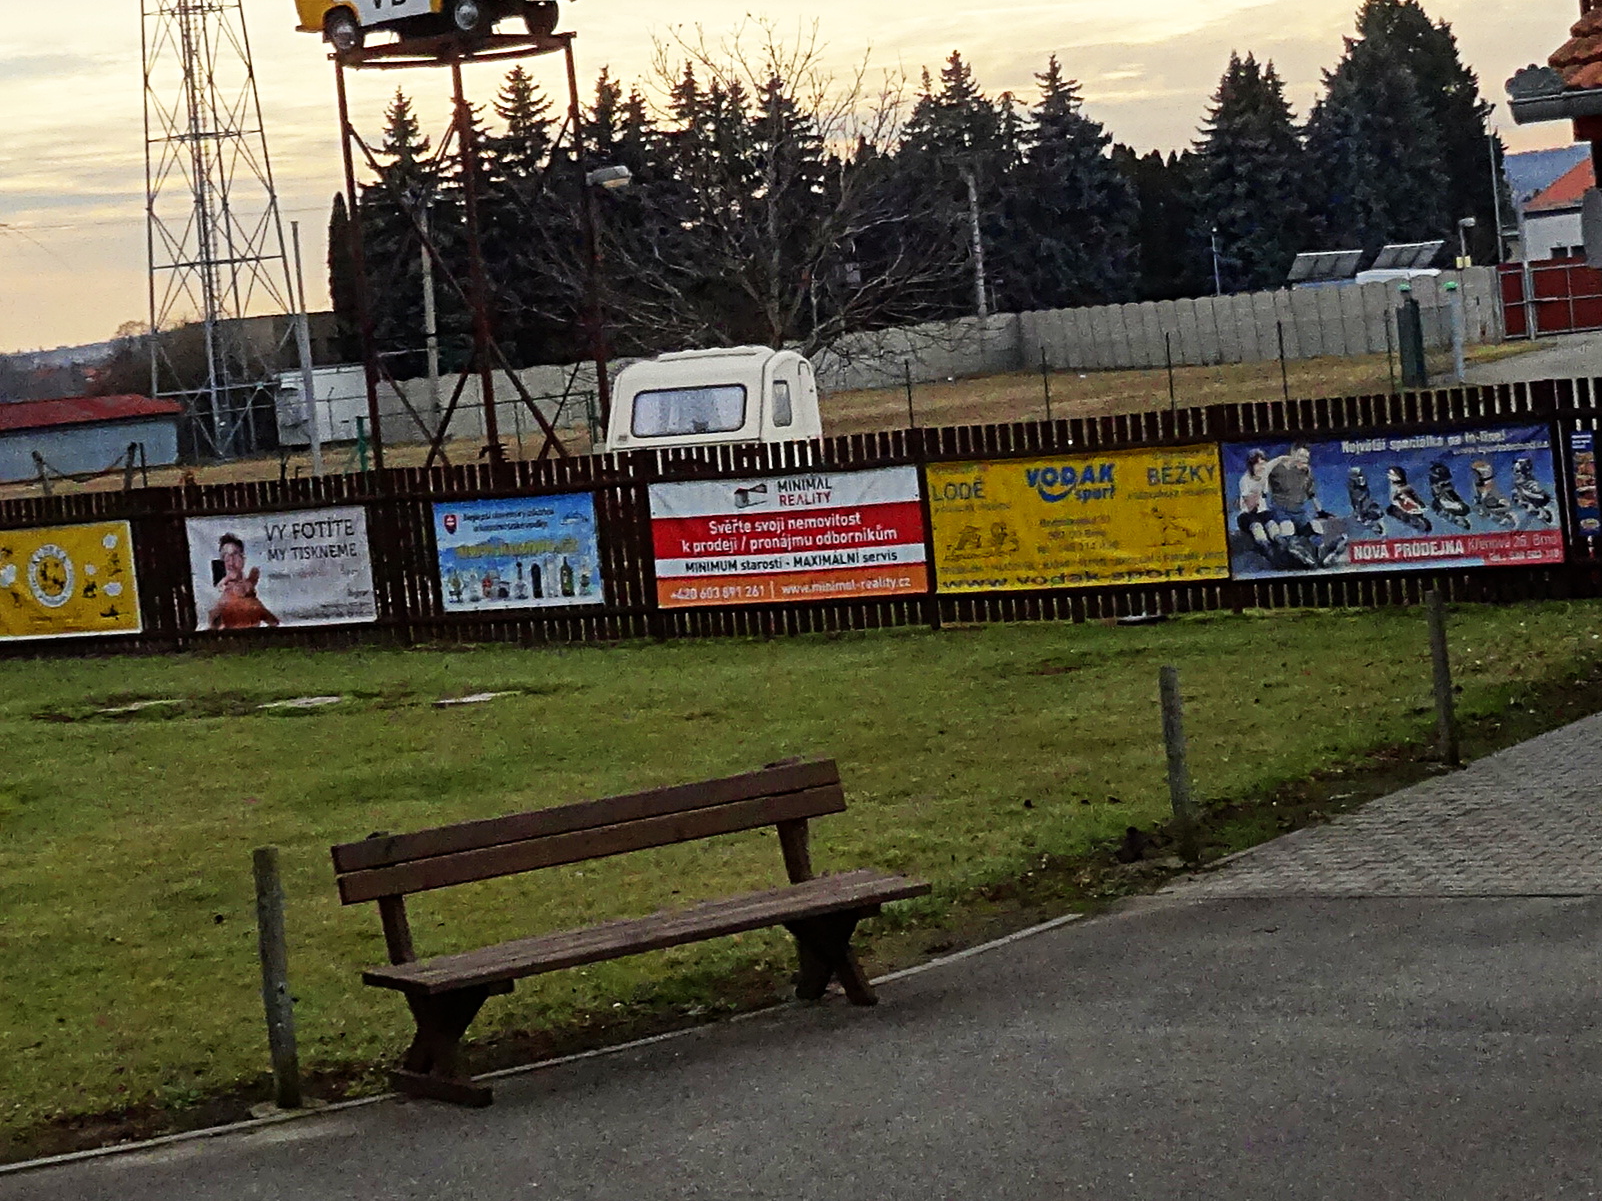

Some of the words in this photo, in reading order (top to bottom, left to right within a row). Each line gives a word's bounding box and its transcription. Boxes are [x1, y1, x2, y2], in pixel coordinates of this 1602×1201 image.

[777, 476, 833, 493] MINIMAL
[1026, 463, 1115, 488] VODAK
[778, 491, 832, 507] REALITY
[264, 522, 287, 542] VY
[708, 518, 752, 534] Svěřte
[754, 517, 785, 534] svoji
[788, 512, 862, 530] nemovitost
[267, 548, 286, 562] MY
[289, 542, 358, 560] TISKNEME
[682, 540, 691, 553] k
[693, 537, 738, 556] prodeji
[750, 533, 813, 554] pronájmu
[1394, 539, 1465, 558] PRODEJNA
[685, 559, 738, 573] MINIMUM
[862, 550, 898, 564] servis
